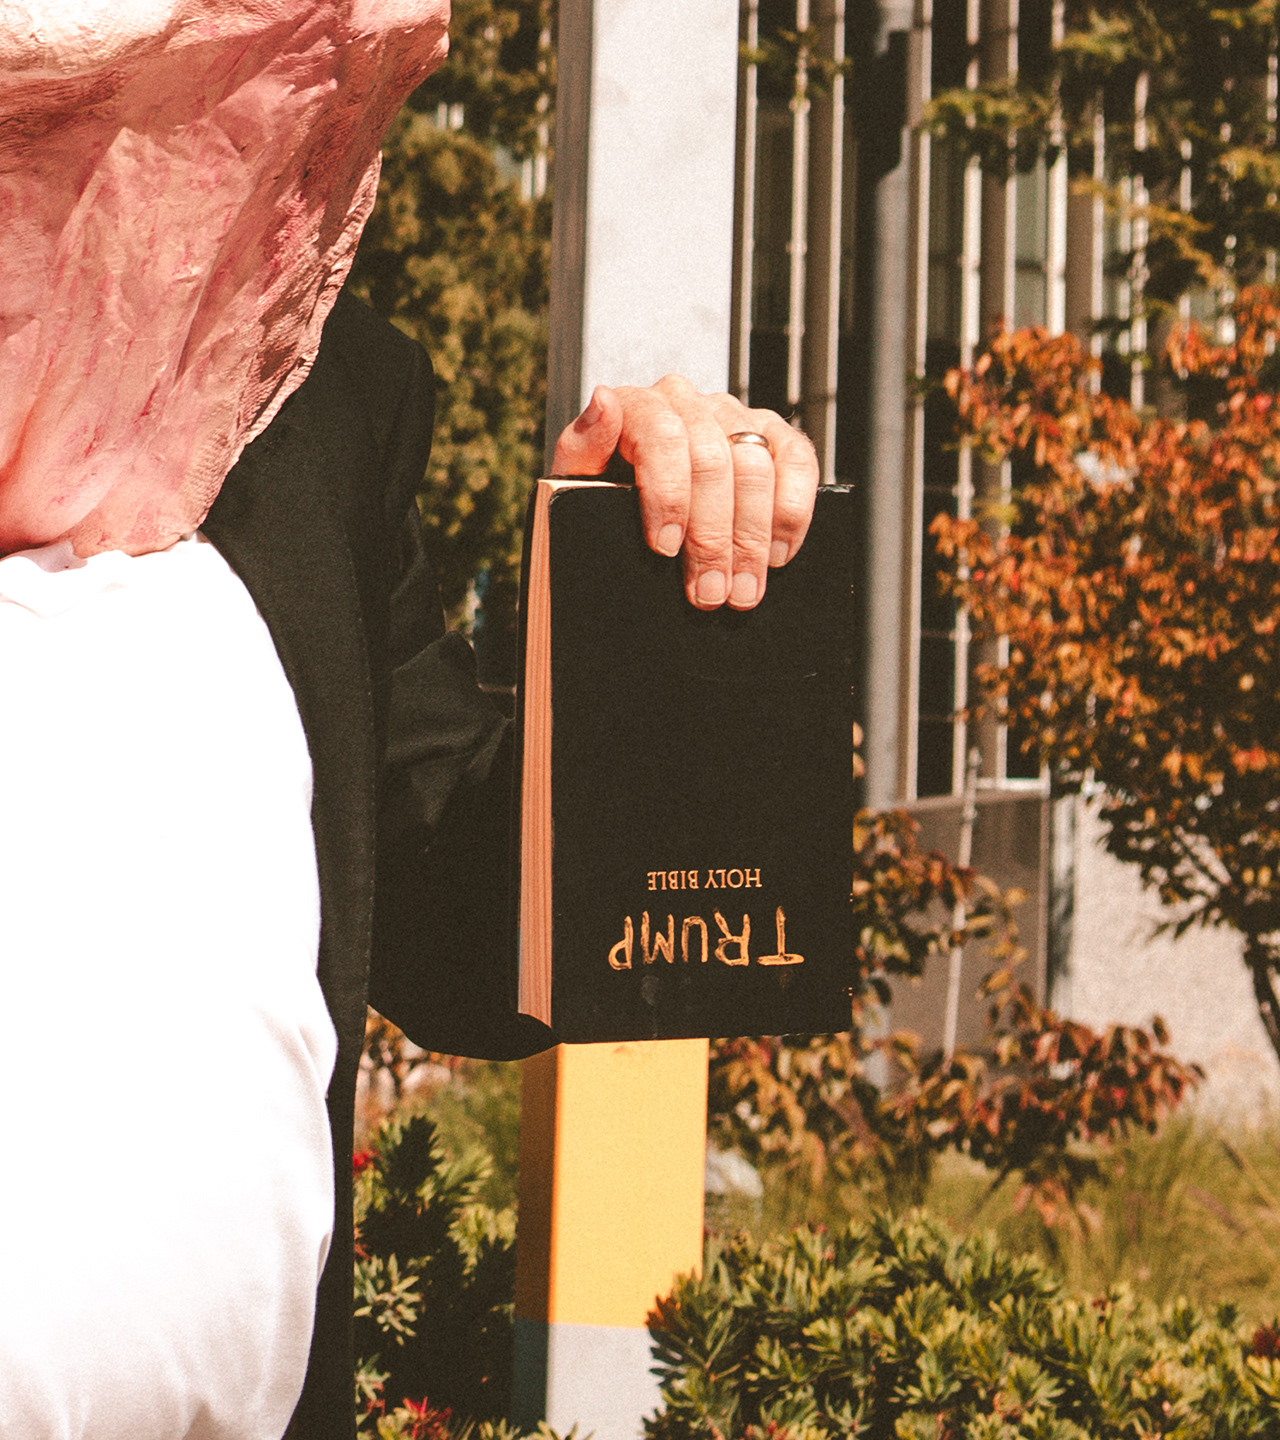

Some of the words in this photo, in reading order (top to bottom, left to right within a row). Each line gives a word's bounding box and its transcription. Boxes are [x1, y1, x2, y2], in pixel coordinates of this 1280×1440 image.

[646, 869, 700, 891] BIBLE
[703, 867, 763, 890] HOLY
[607, 905, 805, 971] TRUMP
